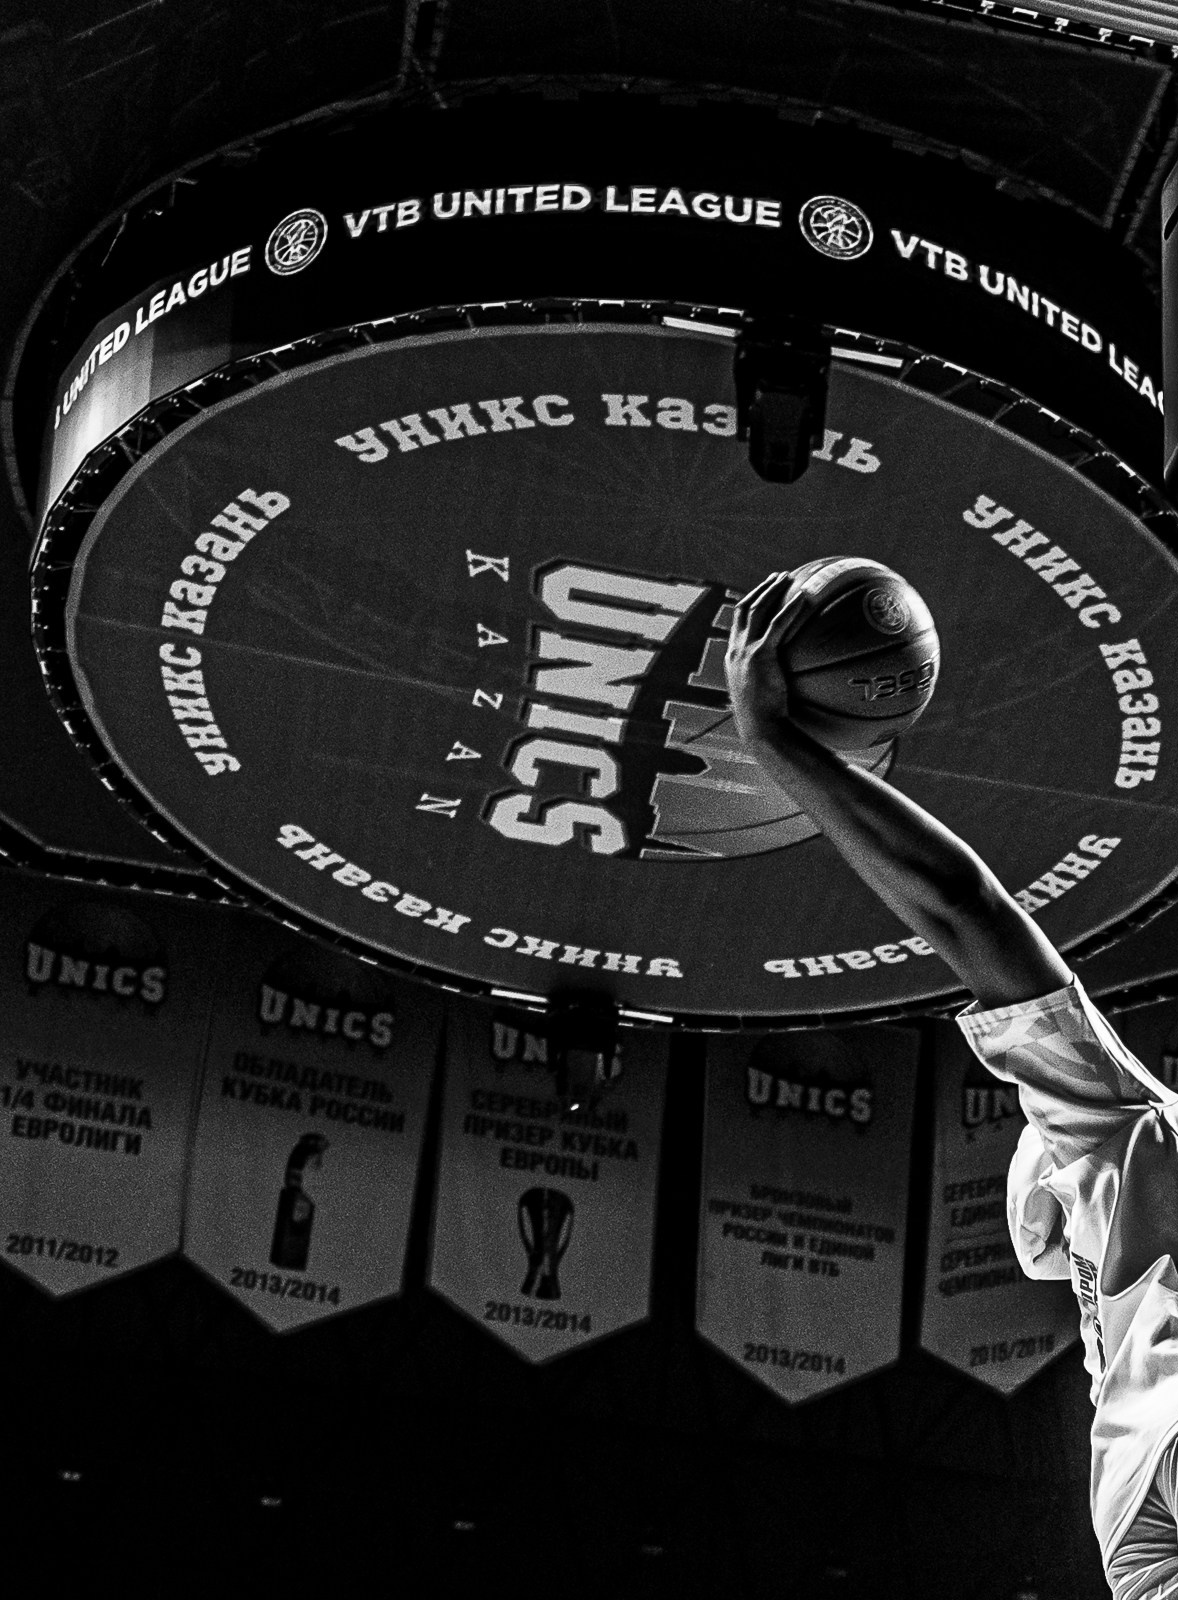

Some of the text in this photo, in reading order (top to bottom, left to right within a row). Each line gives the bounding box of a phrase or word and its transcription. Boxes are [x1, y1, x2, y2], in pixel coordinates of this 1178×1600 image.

[343, 183, 782, 239] VTB UNITED LEAGUE
[62, 245, 253, 416] UNITED LEAGUE
[890, 228, 1164, 417] VTB UNITED LEA
[602, 392, 881, 475] казь
[489, 564, 707, 857] UNICS
[26, 941, 167, 1003] UNICS
[764, 934, 938, 979] азань
[260, 983, 396, 1048] UNICS
[15, 1058, 145, 1101] УЧАСТНИК
[232, 1051, 394, 1105] ОБЛАДАТЕЛЬ
[747, 1066, 873, 1123] UNICS
[43, 1094, 153, 1131] ФИНАЛА
[220, 1075, 406, 1134] КУБКА РОССИИ
[11, 1115, 143, 1156] ЕВРОЛИГИ
[463, 1113, 639, 1162] ПРИЗЕР КУБКА
[500, 1146, 600, 1182] ЕВРОПЫ
[6, 1232, 120, 1269] 2011/2012
[229, 1266, 342, 1306] 2013/2014
[484, 1300, 592, 1333] 2013/2014
[743, 1341, 847, 1375] 2013/2014
